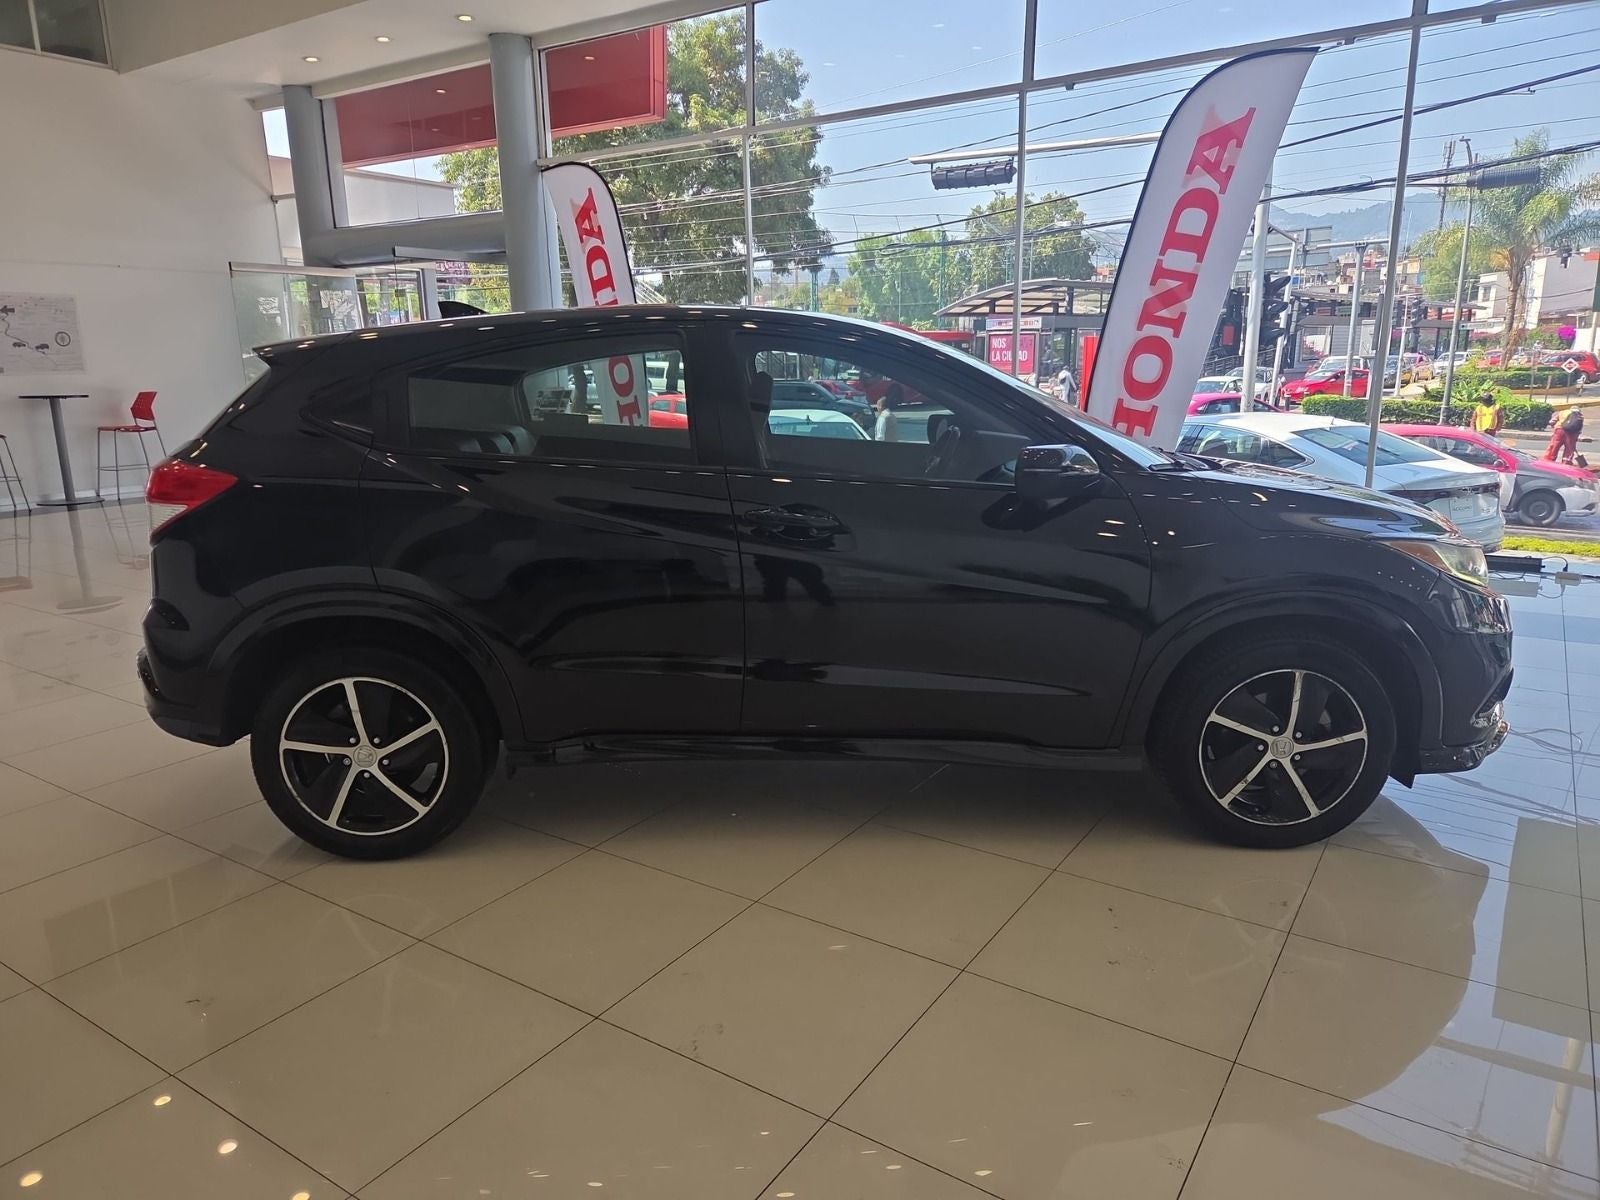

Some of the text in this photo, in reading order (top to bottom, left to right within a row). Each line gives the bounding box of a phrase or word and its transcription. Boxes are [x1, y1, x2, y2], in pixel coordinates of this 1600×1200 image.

[1112, 107, 1256, 437] HONDA
[991, 338, 1007, 349] NOS
[991, 350, 1028, 361] LA CIUAD
